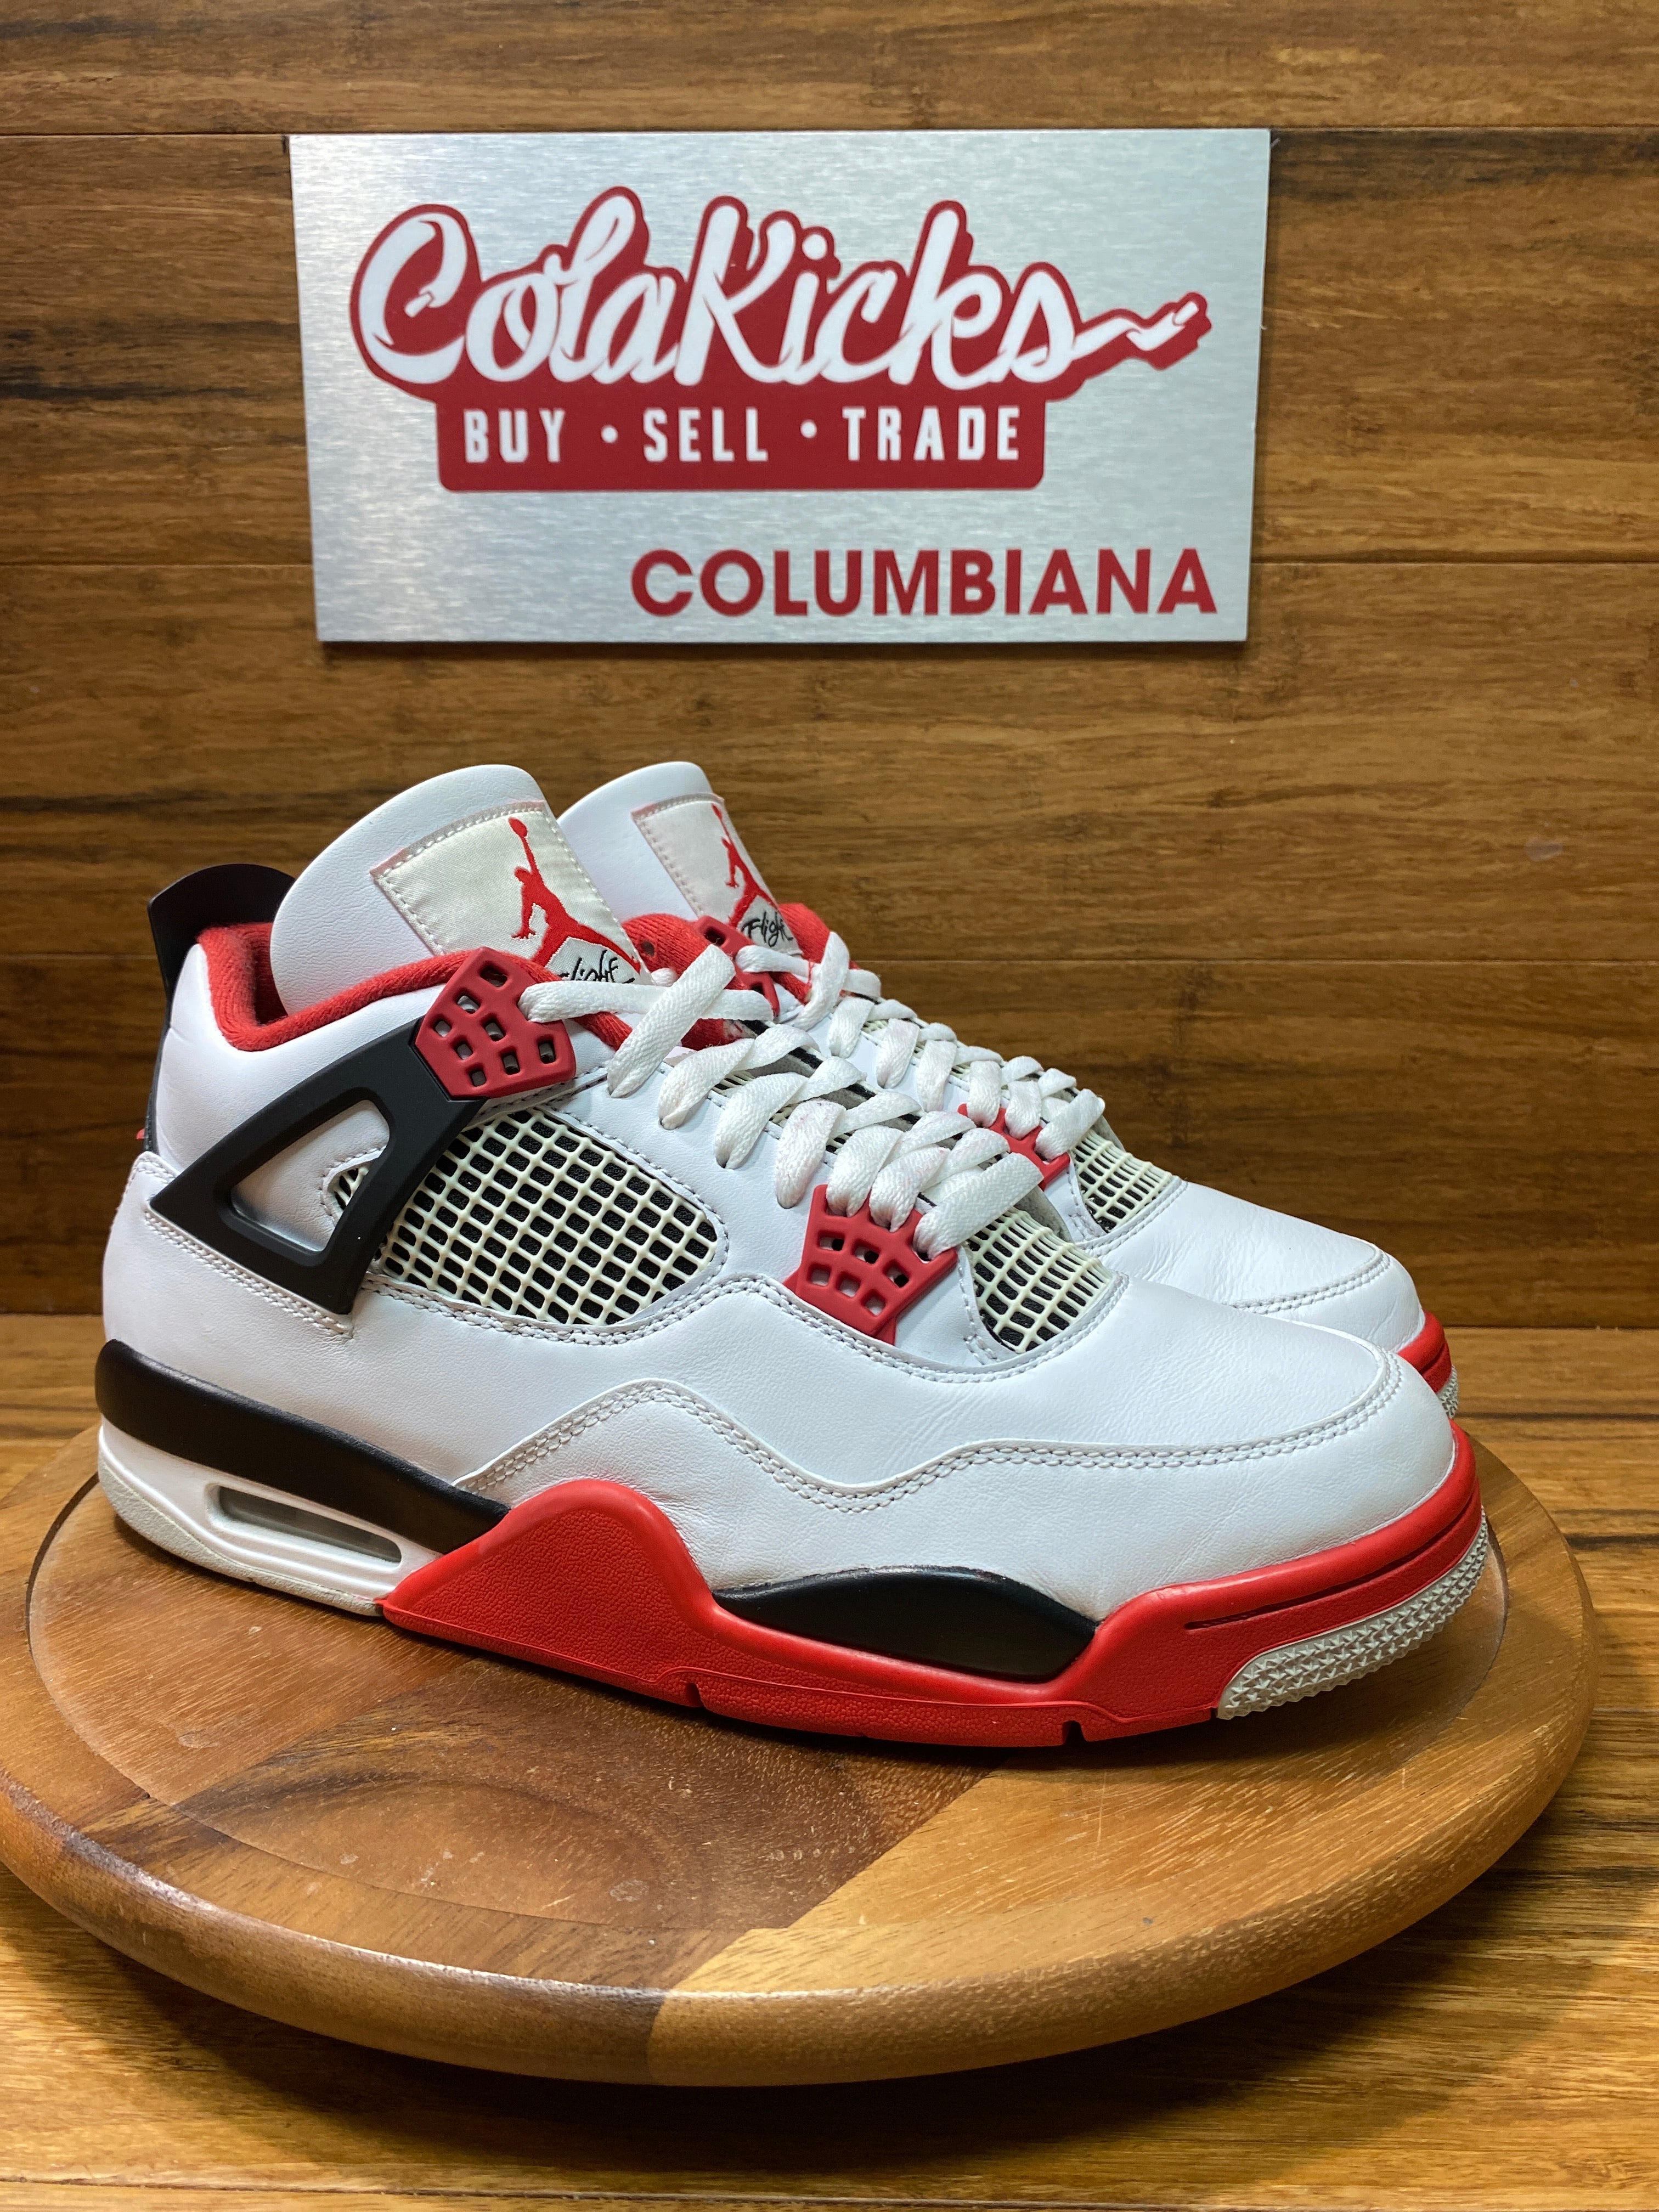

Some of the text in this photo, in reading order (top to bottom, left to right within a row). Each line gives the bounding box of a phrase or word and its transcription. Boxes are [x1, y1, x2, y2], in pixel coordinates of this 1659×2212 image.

[354, 187, 1203, 391] ColaKicks
[463, 405, 1020, 464] BUY SELL TRADE
[631, 549, 1217, 617] COLUMBIANA
[741, 910, 794, 948] Flight
